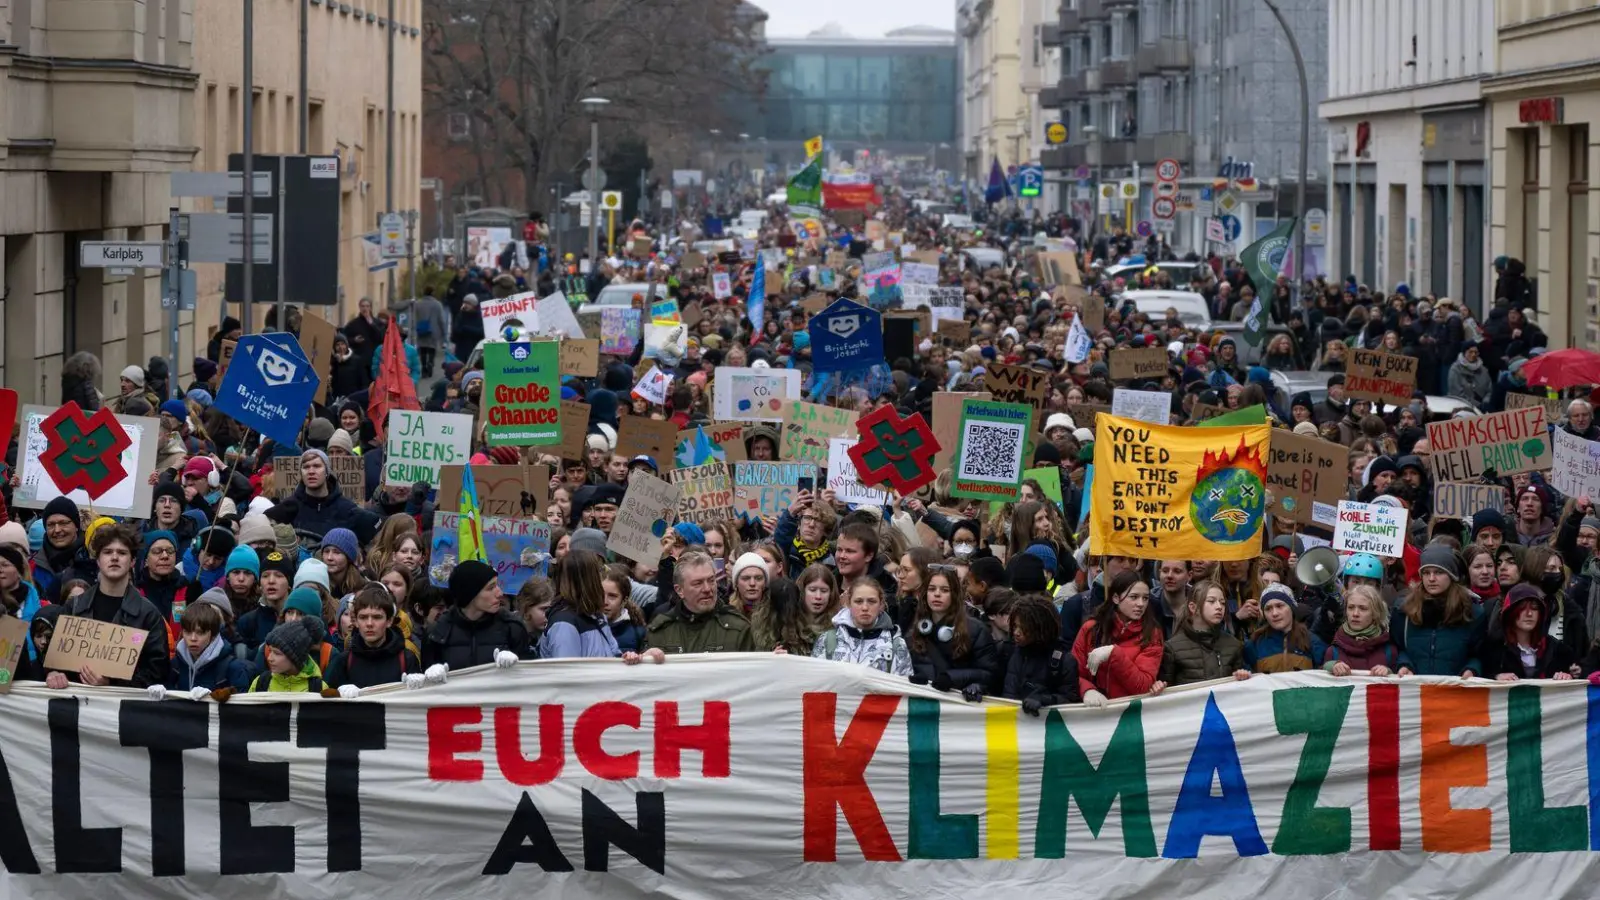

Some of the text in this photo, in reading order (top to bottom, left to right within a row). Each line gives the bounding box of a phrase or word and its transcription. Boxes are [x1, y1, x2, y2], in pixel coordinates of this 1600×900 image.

[1162, 164, 1175, 176] 30
[1218, 156, 1252, 177] dm
[482, 296, 536, 318] ZUKUNFT
[1386, 356, 1414, 373] BOCK
[495, 383, 550, 404] Große
[398, 413, 425, 437] JA
[488, 405, 558, 426] Chance
[1108, 425, 1151, 443] YOU
[1429, 406, 1548, 452] KLIMASCHUTZ
[389, 440, 464, 463] LEBENS-
[1113, 443, 1170, 464] NEED
[1269, 447, 1333, 468] here is no
[1434, 441, 1523, 482] WEIL BAUM
[702, 464, 725, 477] OUR
[735, 463, 770, 487] GANZ
[1137, 468, 1179, 484] THIS
[829, 476, 844, 489] NO
[956, 482, 1017, 497] berlin2030.org
[1113, 481, 1172, 499] EARTH,
[1266, 468, 1319, 496] anet B!
[678, 489, 732, 511] SO STOP
[760, 487, 792, 513] EIS
[1113, 499, 1125, 511] SO
[1435, 483, 1506, 517] GO VEGAN
[679, 506, 734, 524] FUCKING IT
[1113, 515, 1184, 532] DESTROY
[1340, 511, 1371, 523] KOHLE
[1352, 523, 1399, 537] ZUKUNFT
[1134, 536, 1159, 548] IT
[1344, 538, 1394, 554] KRAFTWERK
[62, 616, 126, 645] THERE IS
[57, 637, 138, 666] NO PLANET B
[427, 700, 731, 785] EUCH
[481, 786, 666, 876] AN
